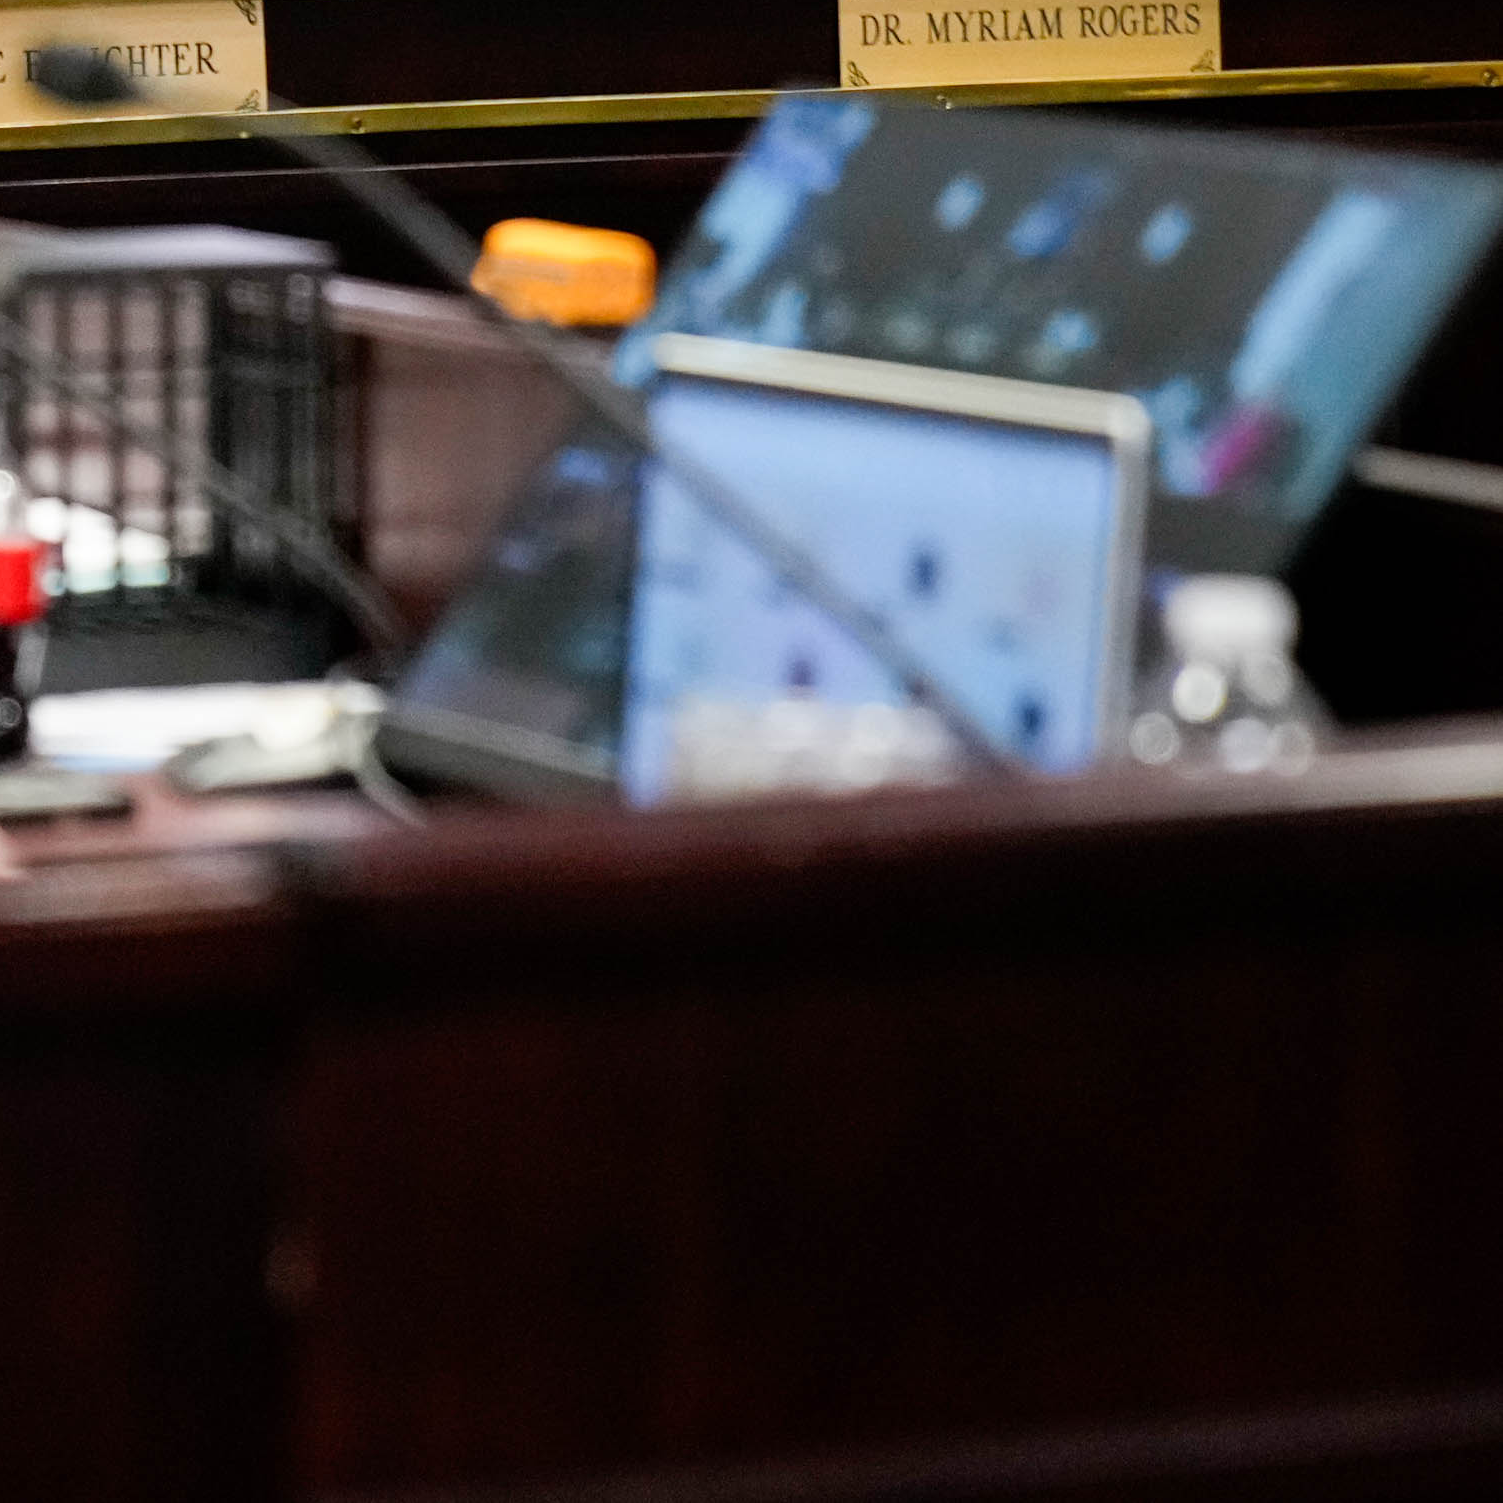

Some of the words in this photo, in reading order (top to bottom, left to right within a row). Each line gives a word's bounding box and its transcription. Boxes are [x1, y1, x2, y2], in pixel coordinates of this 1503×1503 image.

[860, 14, 913, 46] DR.
[926, 7, 1064, 44] MYRIAM
[1079, 3, 1201, 38] ROGERS
